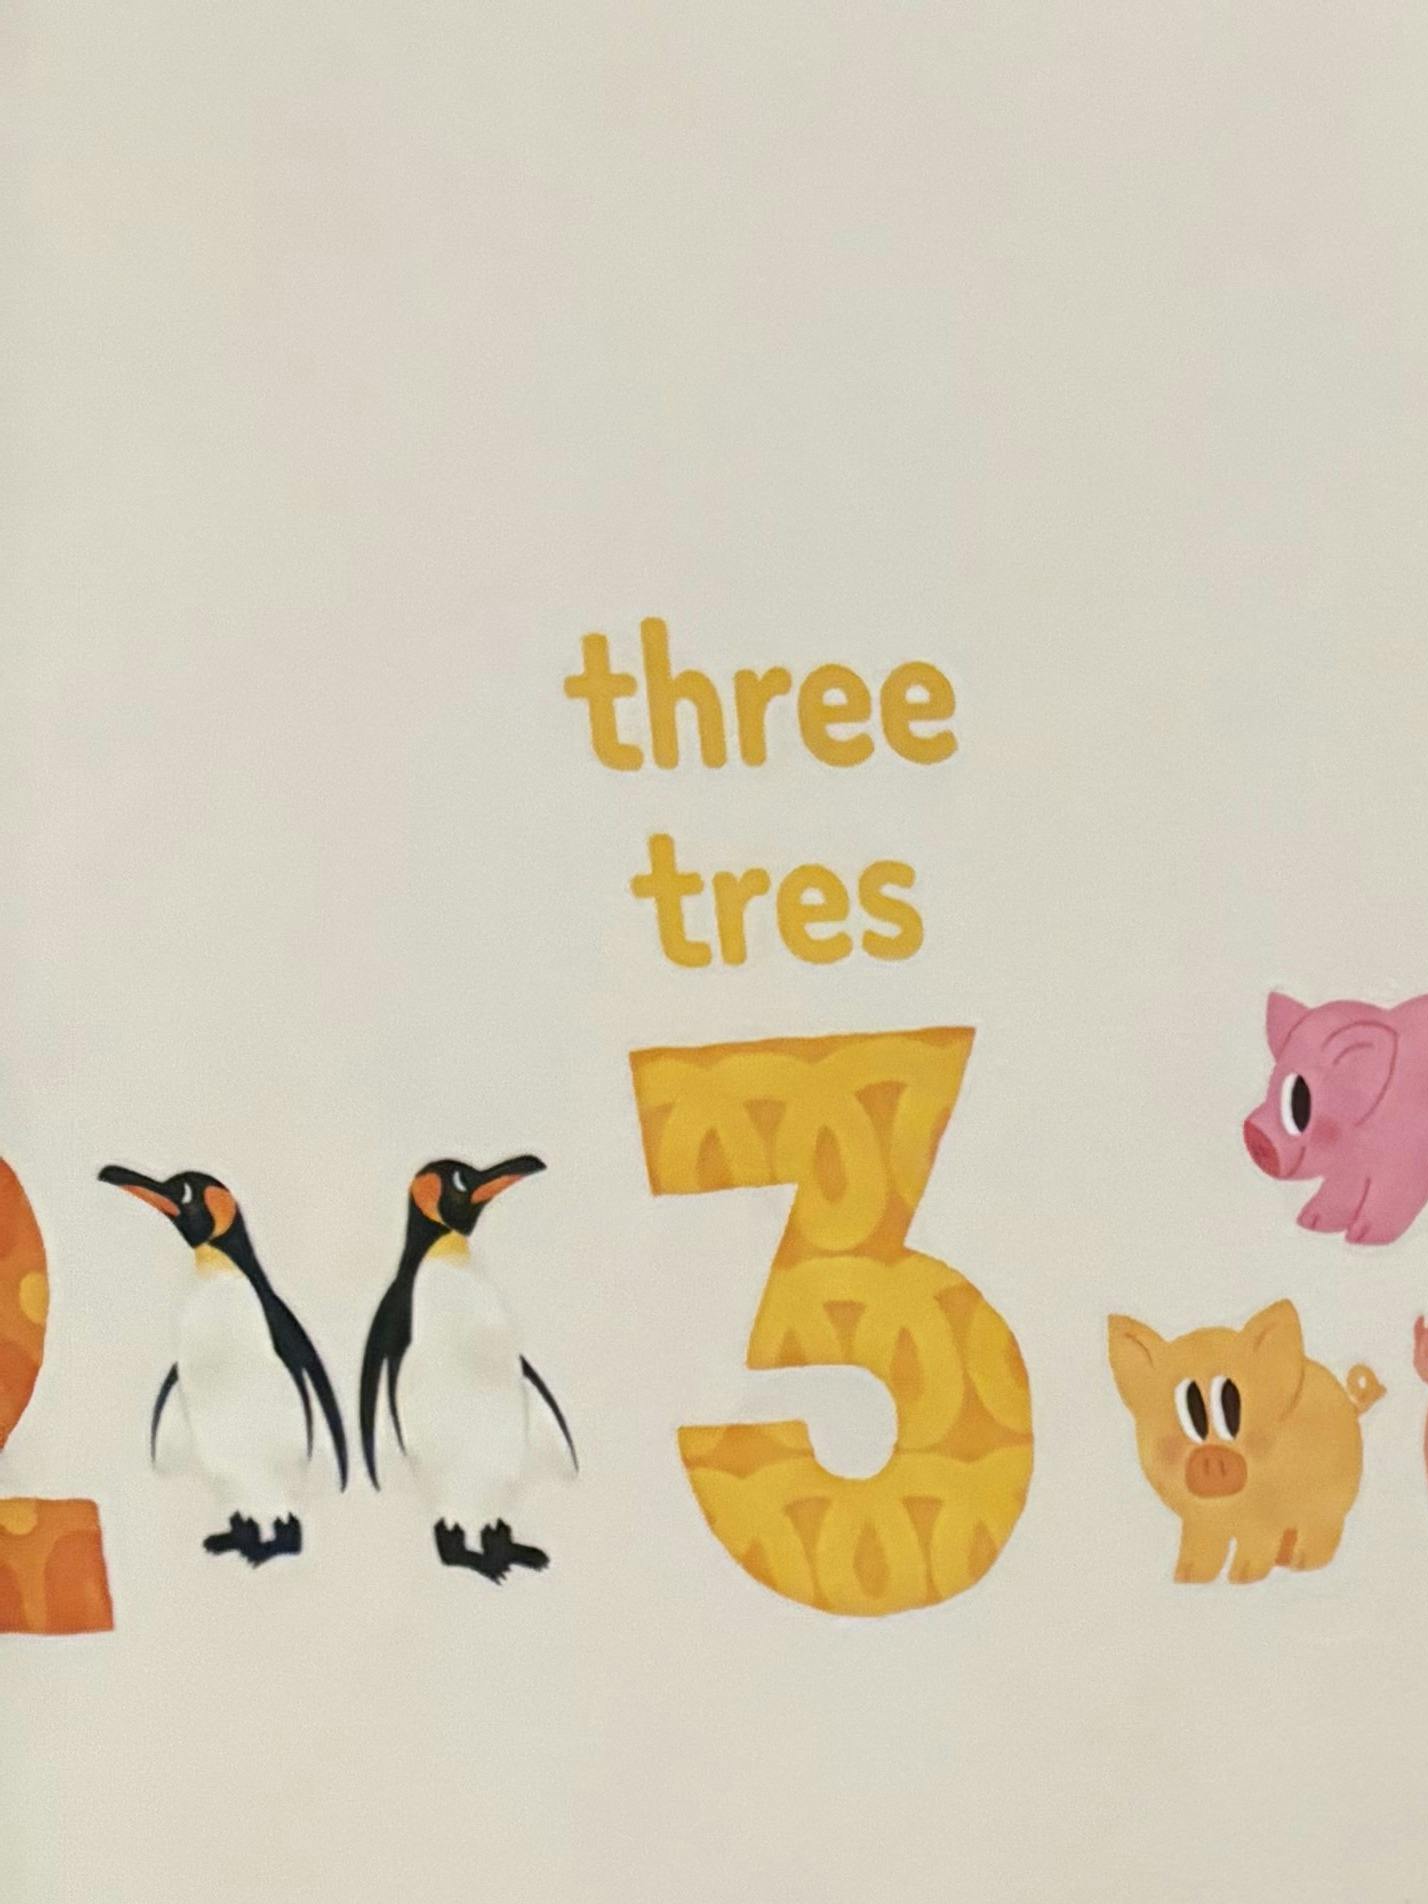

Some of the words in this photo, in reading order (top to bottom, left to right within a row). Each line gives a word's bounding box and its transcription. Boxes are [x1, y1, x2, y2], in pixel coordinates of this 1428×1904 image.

[562, 615, 958, 773] three
[628, 831, 925, 970] tres
[627, 1024, 1036, 1619] 3
